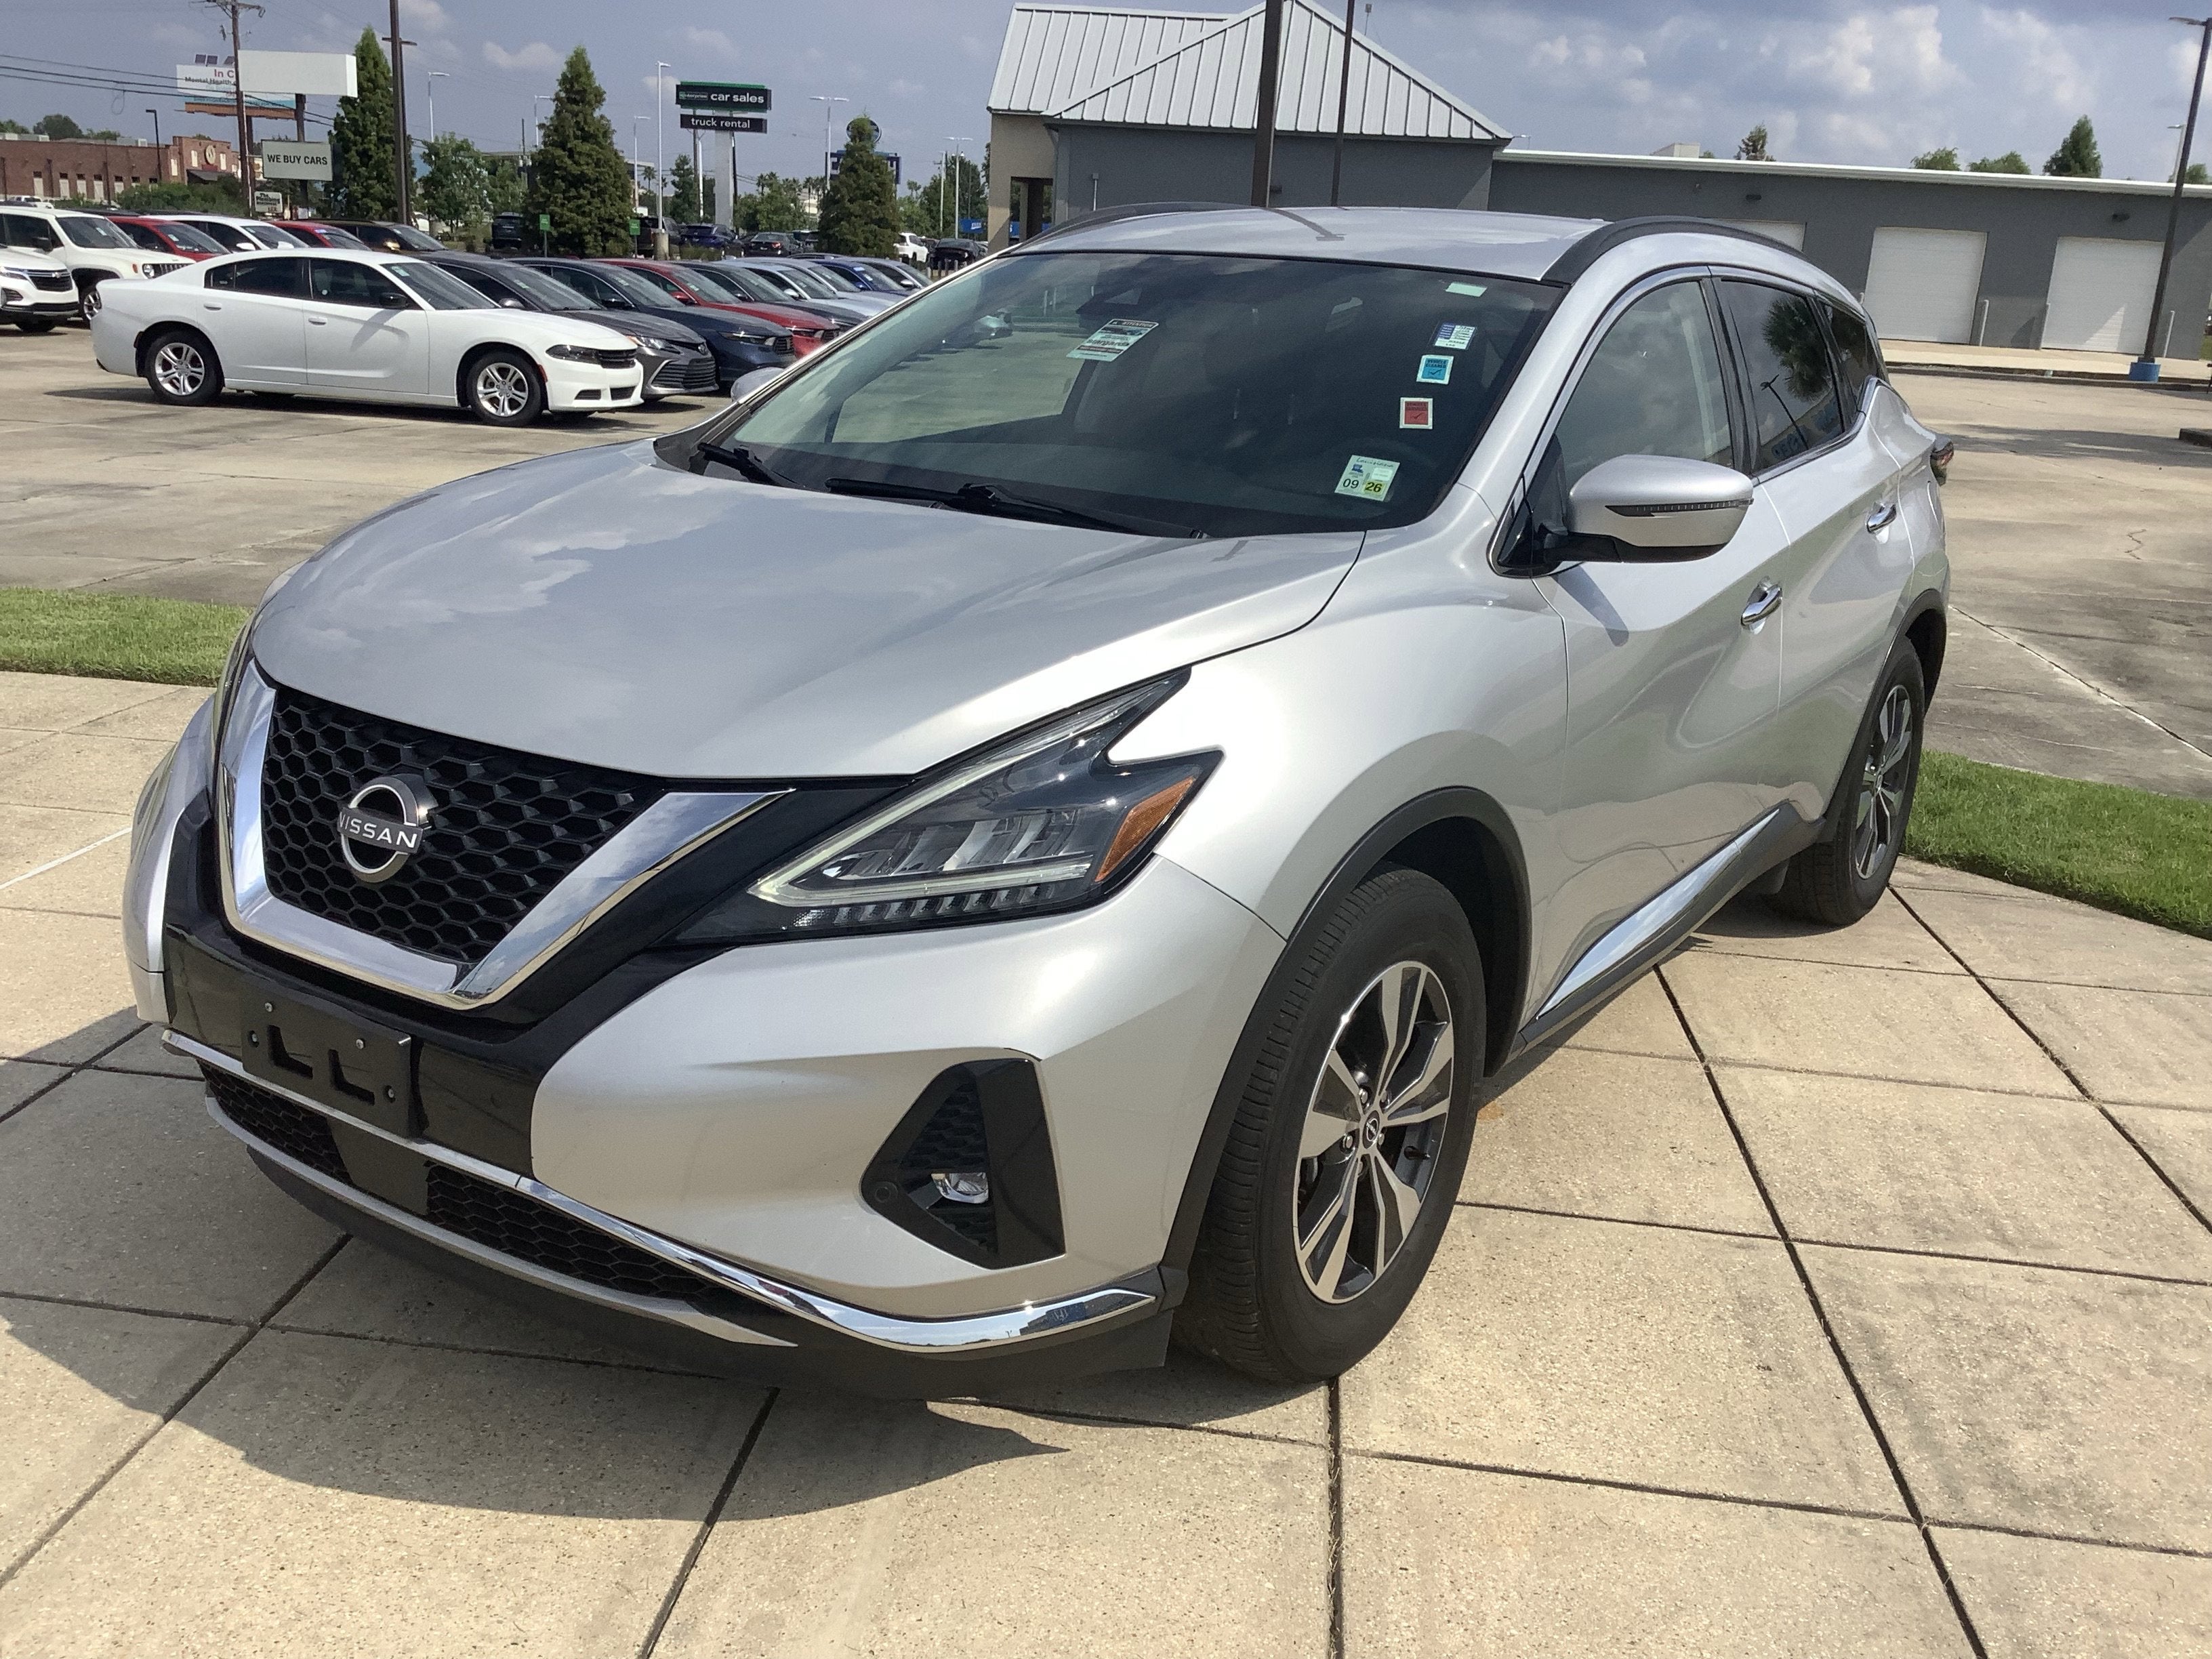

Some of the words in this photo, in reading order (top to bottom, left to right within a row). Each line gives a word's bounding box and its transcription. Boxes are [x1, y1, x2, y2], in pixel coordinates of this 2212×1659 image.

[214, 69, 224, 77] In
[710, 94, 730, 102] car
[733, 93, 764, 104] sales
[691, 118, 717, 127] truck
[720, 119, 750, 128] rental
[267, 155, 281, 163] WE
[283, 155, 302, 164] BUY
[304, 156, 328, 165] CARS
[1343, 478, 1359, 489] 09
[1365, 482, 1383, 493] 26
[340, 811, 417, 848] NISSAN
